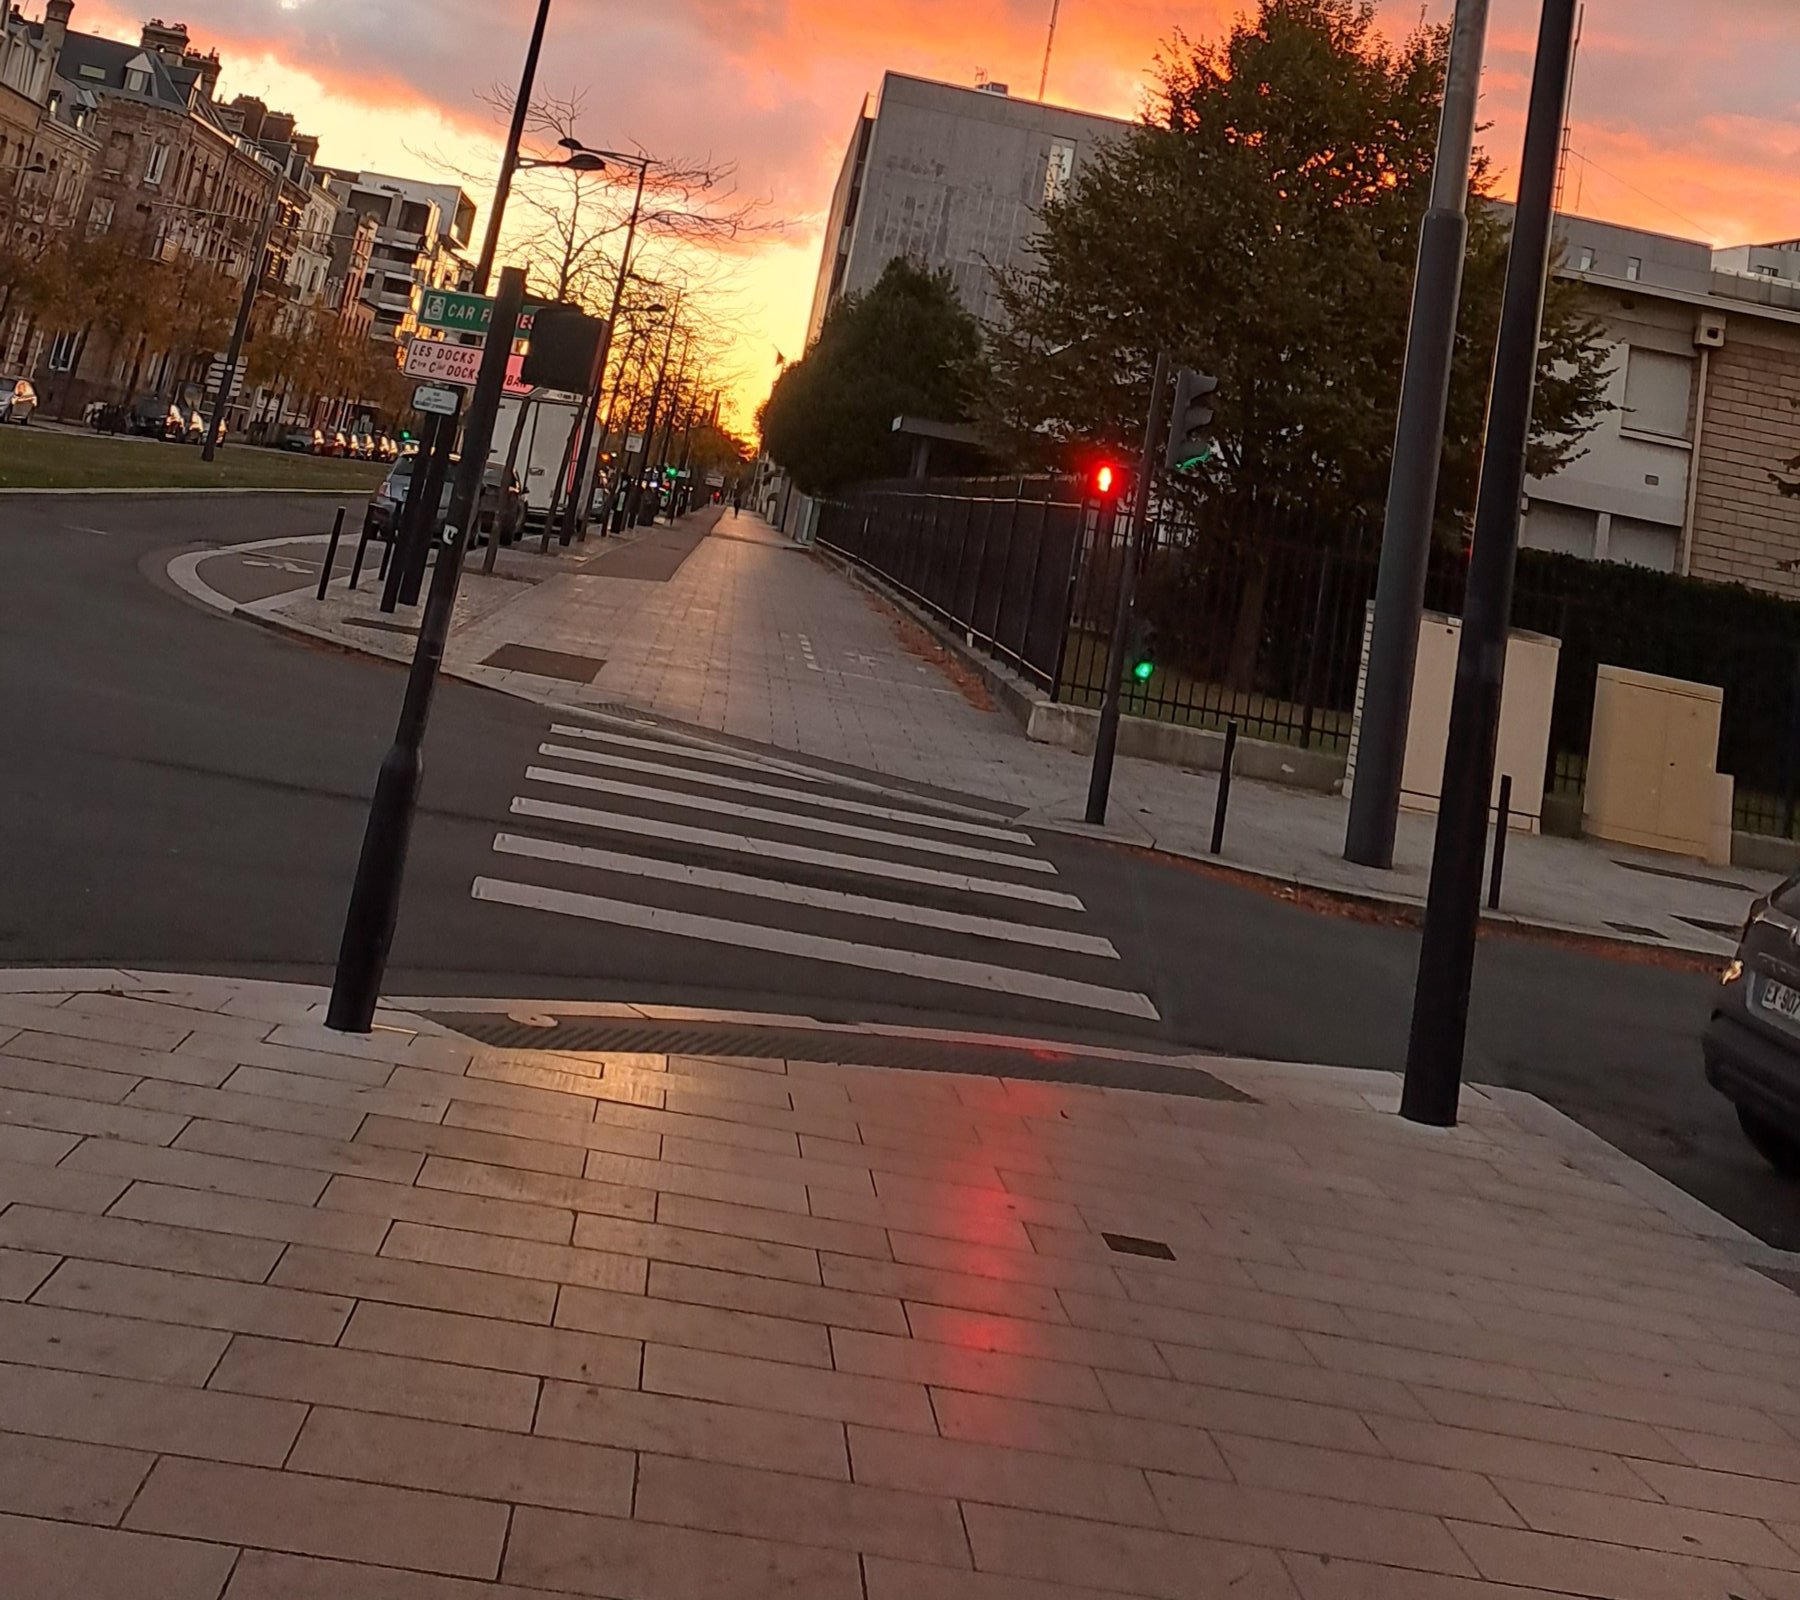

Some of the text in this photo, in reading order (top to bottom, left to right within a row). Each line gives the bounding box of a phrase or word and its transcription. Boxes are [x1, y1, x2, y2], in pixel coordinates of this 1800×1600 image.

[447, 304, 475, 320] CAR
[412, 344, 475, 364] LES DOCKS
